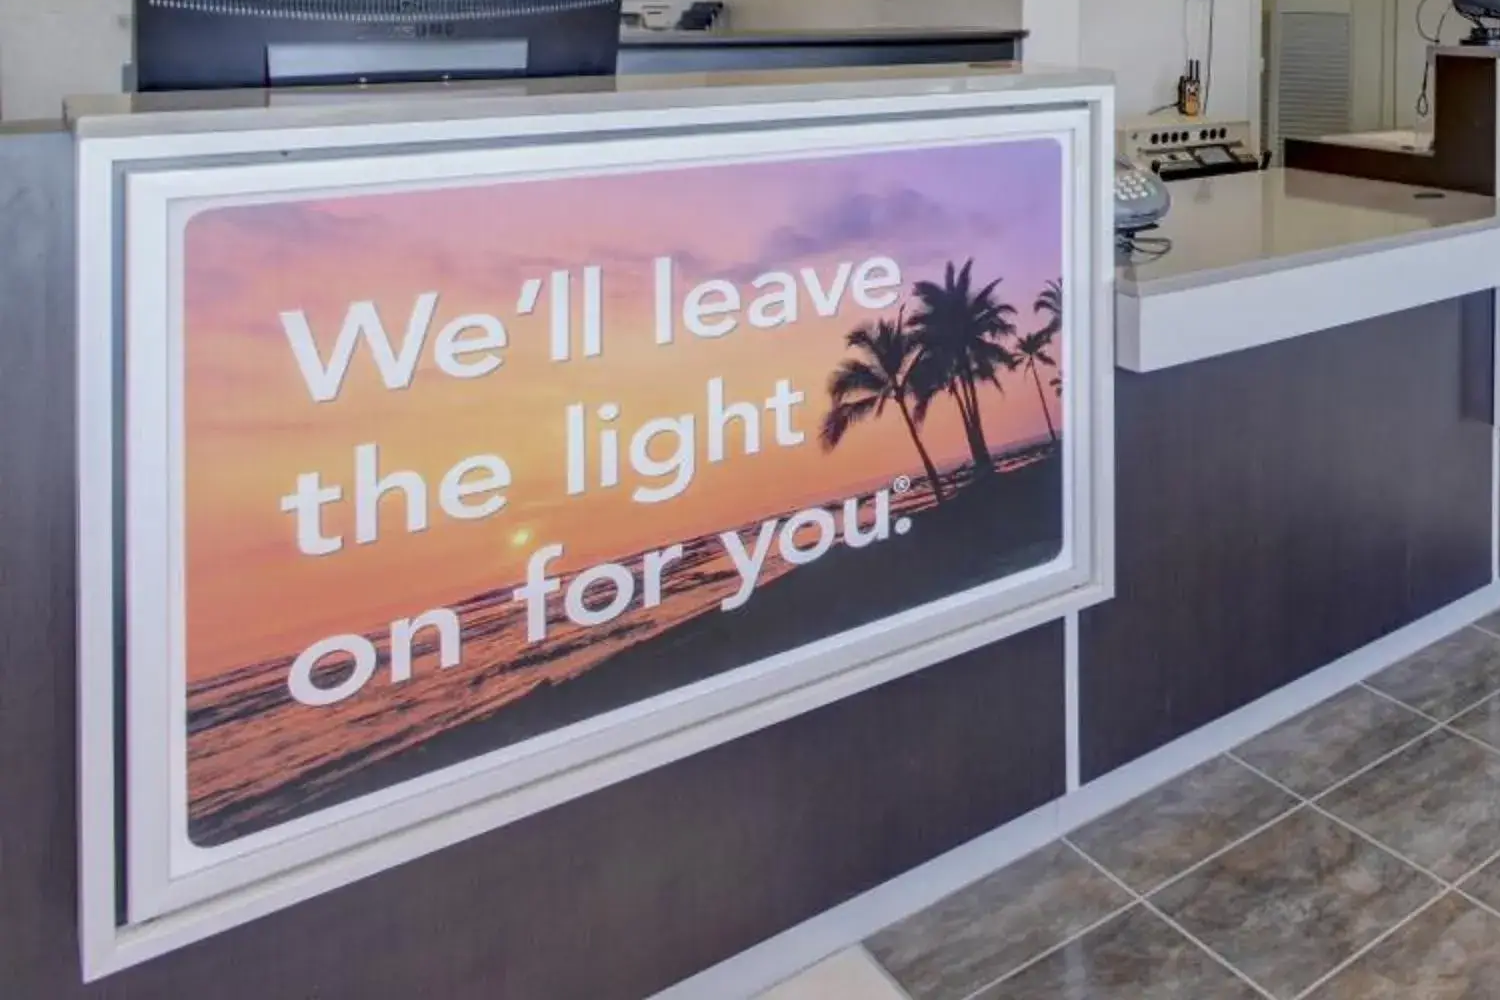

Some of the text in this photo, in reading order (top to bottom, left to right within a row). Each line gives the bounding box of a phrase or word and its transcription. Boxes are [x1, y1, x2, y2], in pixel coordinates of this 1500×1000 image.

[279, 256, 903, 403] We'll leave
[280, 376, 805, 556] the light
[287, 604, 461, 708] on
[512, 543, 684, 643] for
